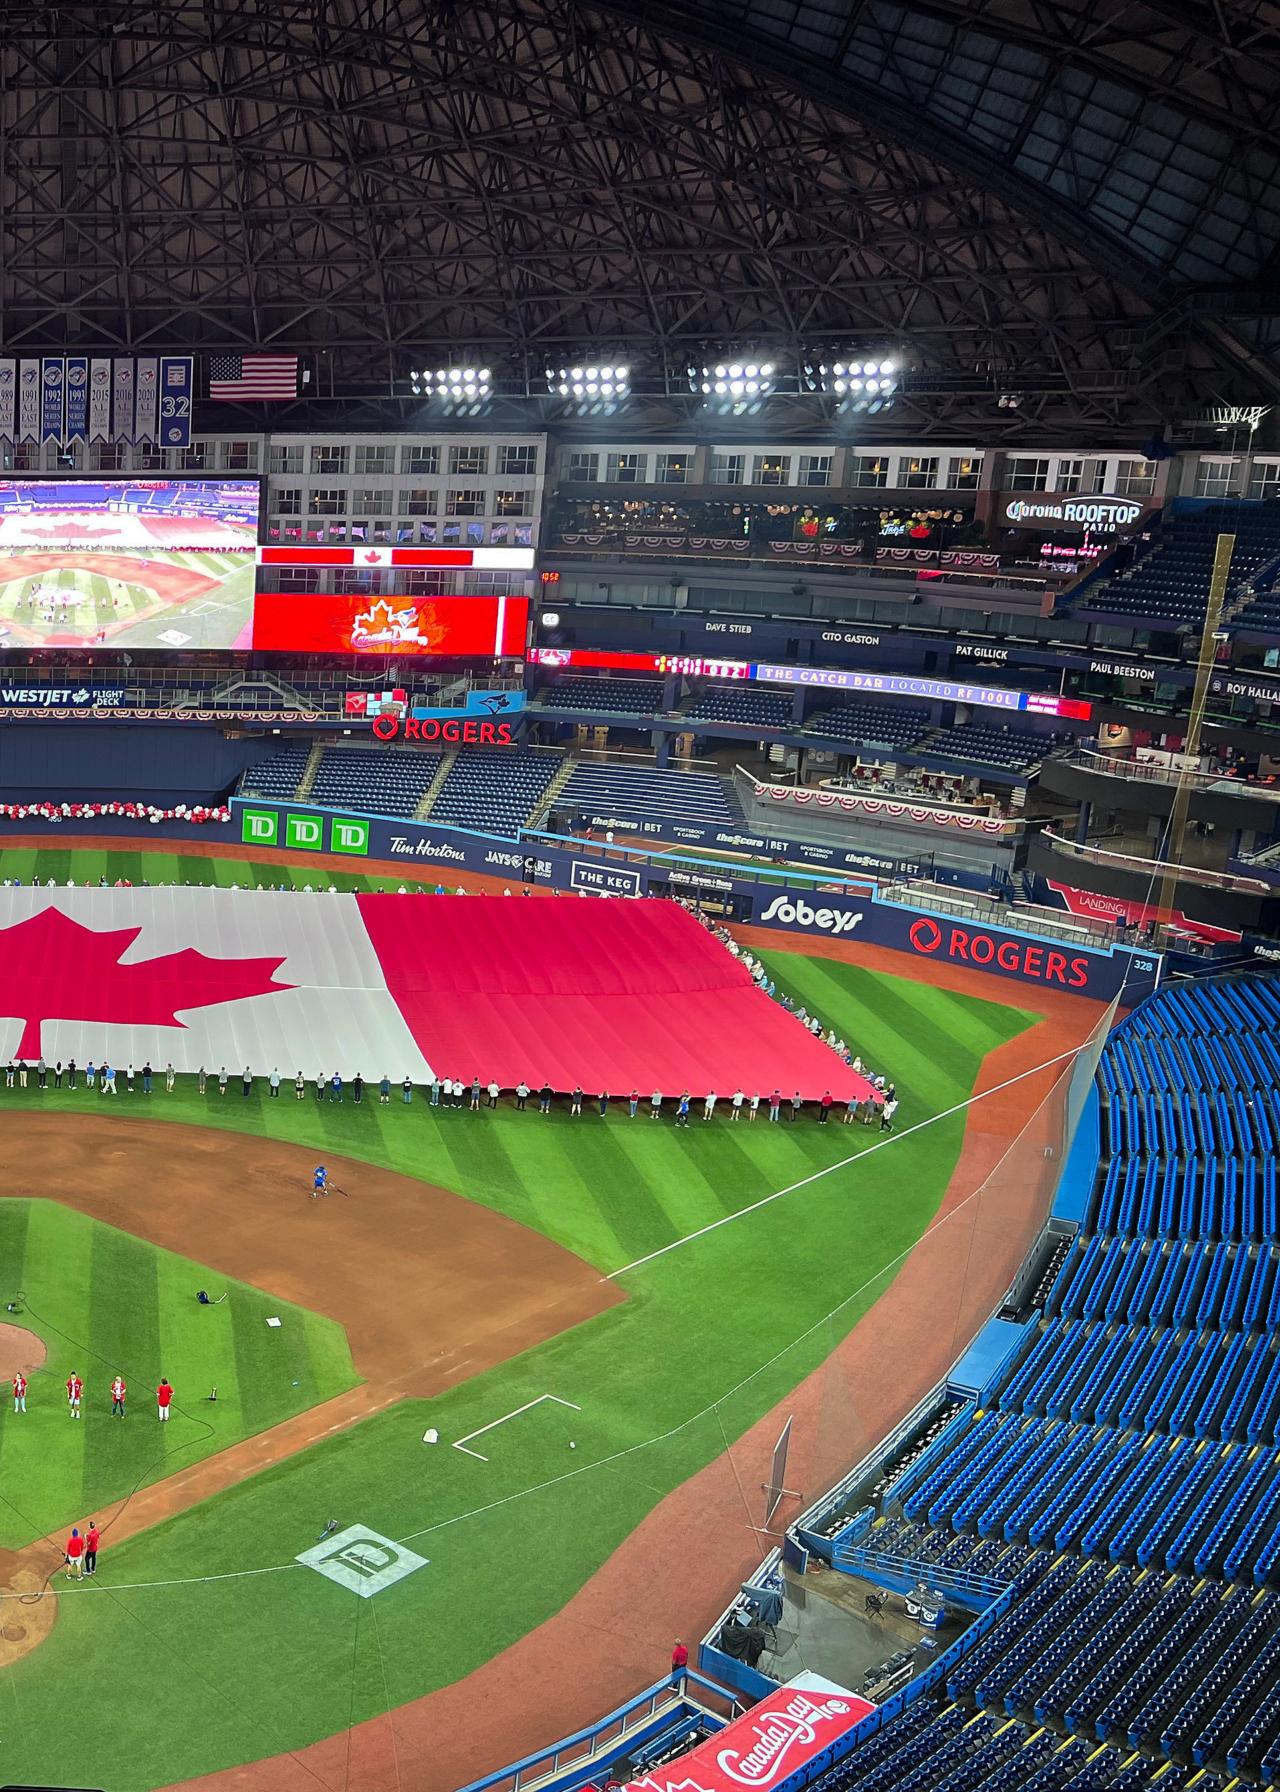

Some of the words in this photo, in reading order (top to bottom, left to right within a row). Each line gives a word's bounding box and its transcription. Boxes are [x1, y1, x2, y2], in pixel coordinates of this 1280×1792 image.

[22, 389, 37, 401] 1991
[45, 389, 61, 402] 1992
[69, 389, 85, 402] 1993
[92, 389, 109, 401] 2015
[116, 389, 132, 401] 2016
[138, 389, 155, 401] 2020
[161, 395, 190, 418] 32
[1006, 501, 1063, 521] Corona
[1064, 504, 1140, 524] ROOFTOP
[1083, 522, 1116, 532] PATIO
[705, 622, 727, 632] DAVE
[729, 623, 752, 634] STIEB
[822, 632, 842, 643] CITO
[844, 633, 880, 646] GASTON
[956, 645, 972, 656] PAT
[974, 647, 1008, 660] GILLICK
[1090, 662, 1113, 675] PAUL
[1113, 666, 1155, 680] BEESTON
[764, 667, 794, 680] THE
[800, 671, 847, 685] CATCH
[854, 676, 883, 688] BAR
[890, 679, 952, 697] LOCATED
[958, 688, 972, 699] RF
[1, 689, 72, 706] WESTJET
[92, 690, 124, 699] FLIGHT
[1227, 683, 1247, 695] ROY
[1248, 686, 1280, 702] HALLA
[97, 697, 120, 706] DECK
[405, 718, 512, 745] ROGERS
[246, 815, 274, 838] TD
[290, 819, 319, 842] TD
[592, 817, 638, 829] theScore
[644, 822, 662, 833] BET
[335, 824, 365, 847] TD
[716, 832, 764, 848] theScore
[770, 840, 789, 852] BET
[389, 836, 418, 854] Tim
[417, 838, 466, 861] Hortons
[485, 851, 511, 866] JAYS
[524, 857, 552, 874] CARE
[900, 862, 919, 874] BET
[579, 870, 604, 883] THE
[607, 876, 633, 889] KEG
[1079, 896, 1124, 914] LANDING
[761, 895, 862, 933] Sobeys
[949, 928, 1089, 988] ROGERS
[1134, 960, 1153, 971] 328
